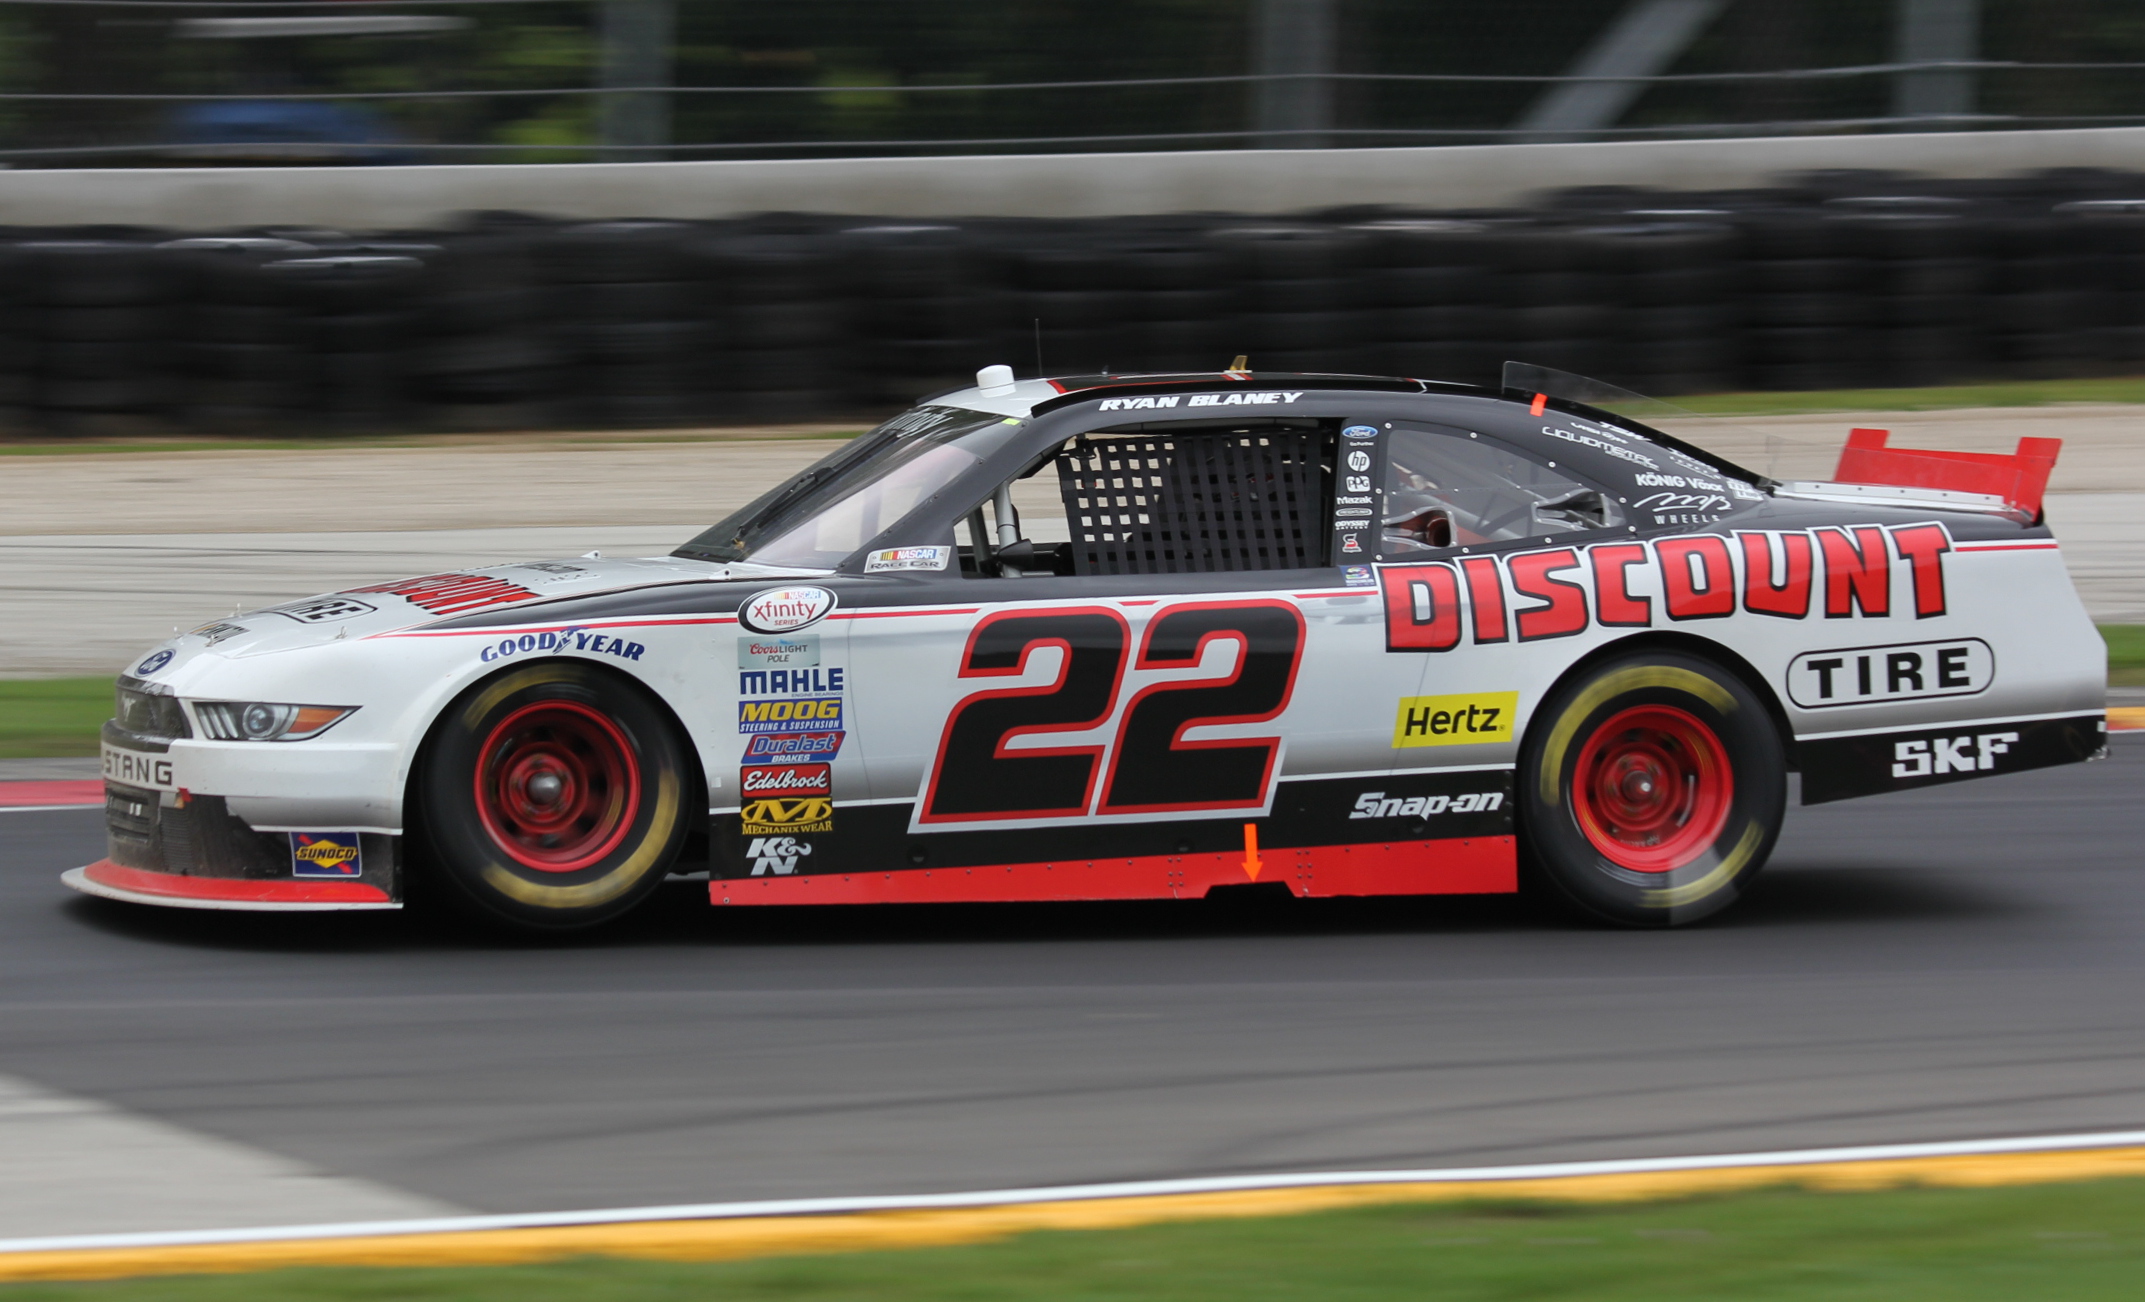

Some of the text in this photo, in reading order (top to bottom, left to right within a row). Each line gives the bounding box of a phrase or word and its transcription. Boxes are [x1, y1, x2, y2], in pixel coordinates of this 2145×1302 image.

[1099, 392, 1304, 411] RYAN BLANEY
[1349, 451, 1369, 472] hp
[1634, 471, 1686, 488] KÖNIG
[1336, 496, 1373, 504] Mazak
[1653, 514, 1720, 525] WHEELS
[898, 549, 935, 560] NASCAR
[910, 560, 949, 568] CAR
[790, 591, 820, 599] NASCAR
[1376, 523, 1951, 652] DISCOUNT
[753, 601, 817, 621] xfinity
[766, 654, 790, 663] POLE
[779, 644, 807, 654] LIGHT
[740, 667, 844, 695] MAHLE
[1807, 647, 1971, 699] TIRE
[740, 699, 841, 722] MOOG
[917, 598, 1307, 824] 22
[1404, 703, 1501, 737] Hertz
[740, 719, 840, 732] STEERING & SUSPENSION
[751, 732, 836, 755] Duralast
[771, 753, 811, 763] BRAKES
[1891, 731, 2020, 779] SKF
[104, 750, 173, 787] STANG
[743, 769, 828, 791] Edelbrock
[1348, 791, 1504, 821] Snap-on
[741, 820, 833, 835] MECHANIX WEAR
[299, 848, 355, 859] SUNOCO
